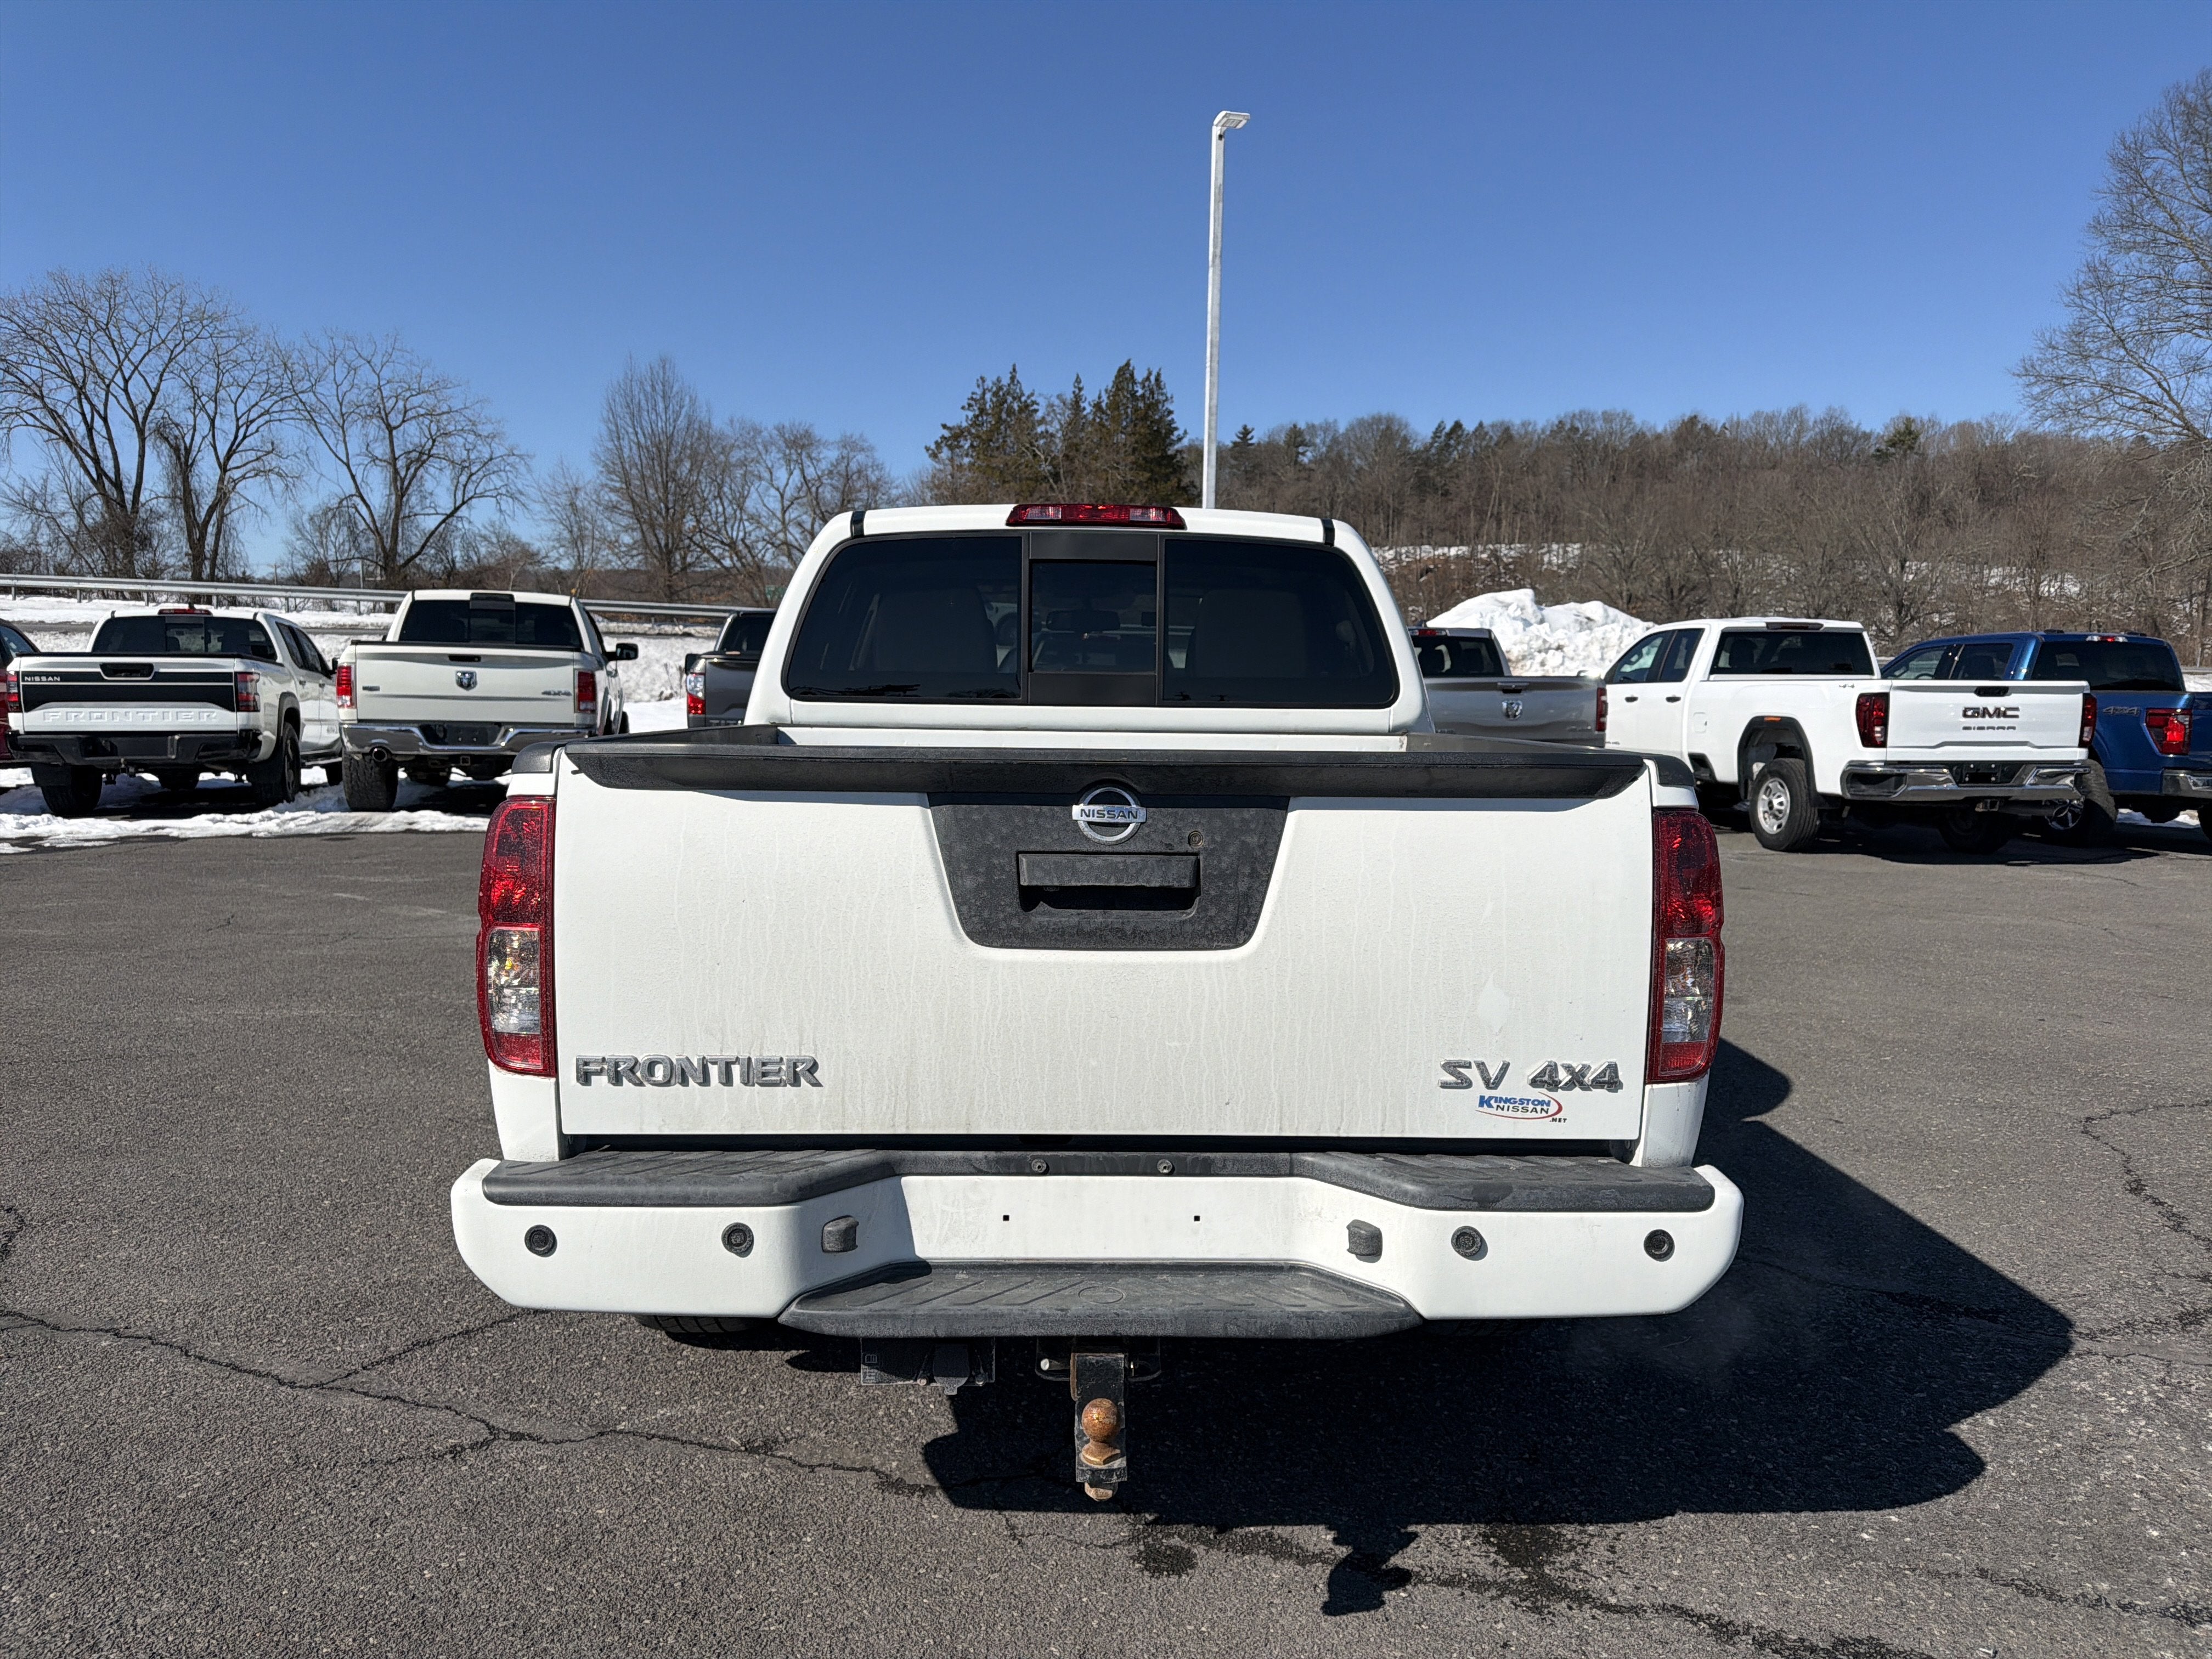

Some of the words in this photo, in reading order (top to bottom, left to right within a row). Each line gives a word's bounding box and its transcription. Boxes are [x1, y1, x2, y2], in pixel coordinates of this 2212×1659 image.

[42, 710, 217, 723] FRONTIER
[1962, 707, 2020, 719] GMC
[1080, 808, 1138, 819] NISSAN
[575, 1054, 824, 1087] FRONTIER
[1437, 1059, 1510, 1090] SV
[1477, 1094, 1551, 1108] KINGSTON
[1496, 1104, 1549, 1115] NISSAN
